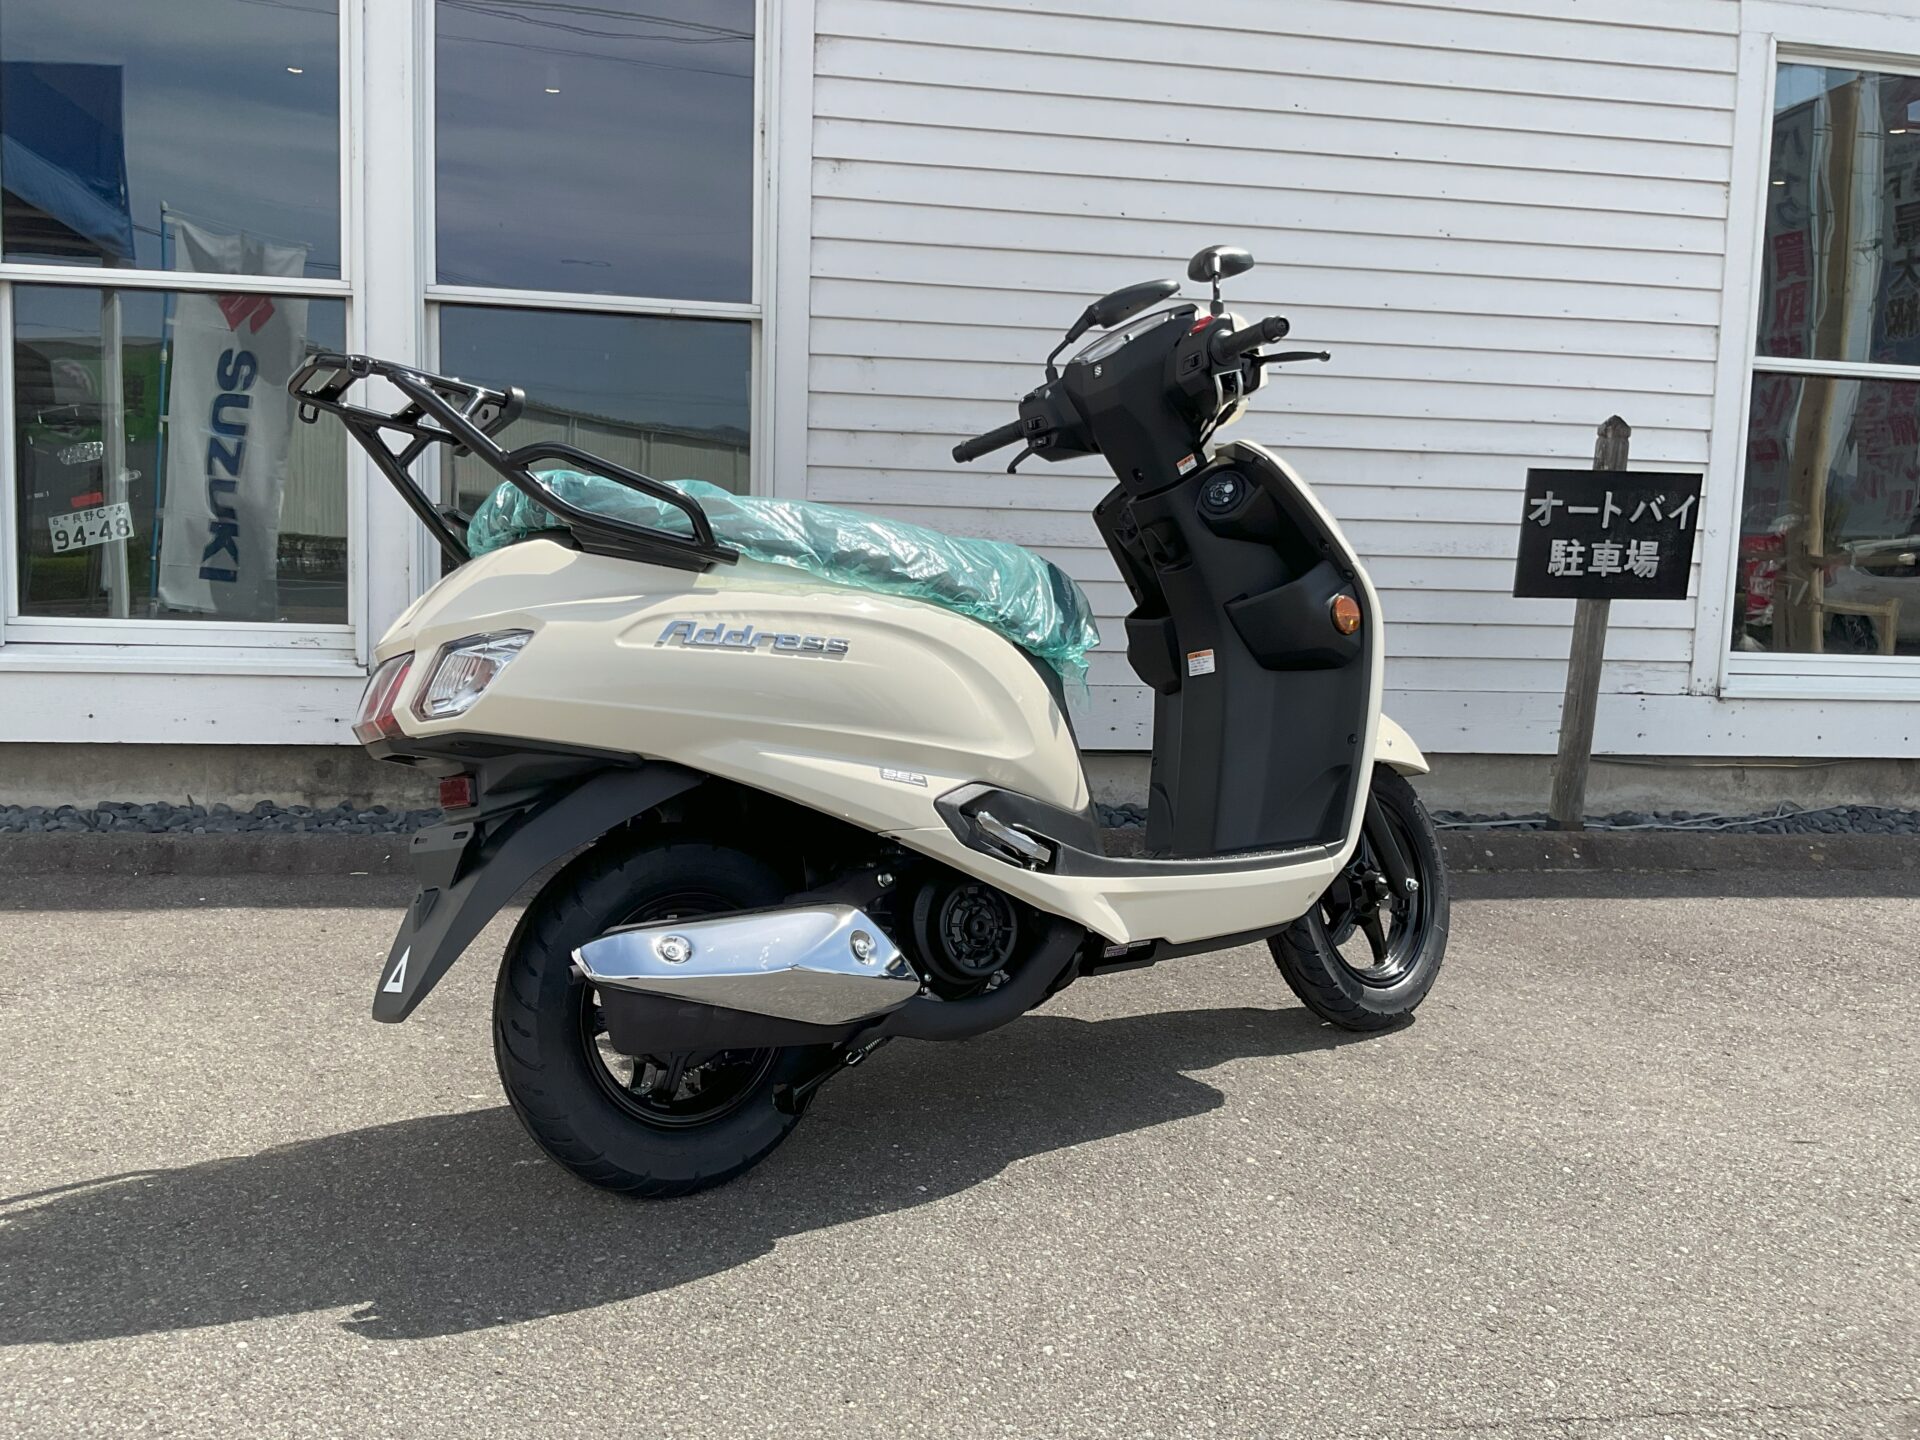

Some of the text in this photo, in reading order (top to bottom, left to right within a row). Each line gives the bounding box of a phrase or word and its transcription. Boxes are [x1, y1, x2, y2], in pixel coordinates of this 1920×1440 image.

[198, 348, 258, 583] SUZUKI
[1527, 490, 1696, 530] オートバイ
[54, 517, 130, 550] 94-48
[1547, 538, 1661, 578] 駐車場
[654, 619, 850, 655] Address
